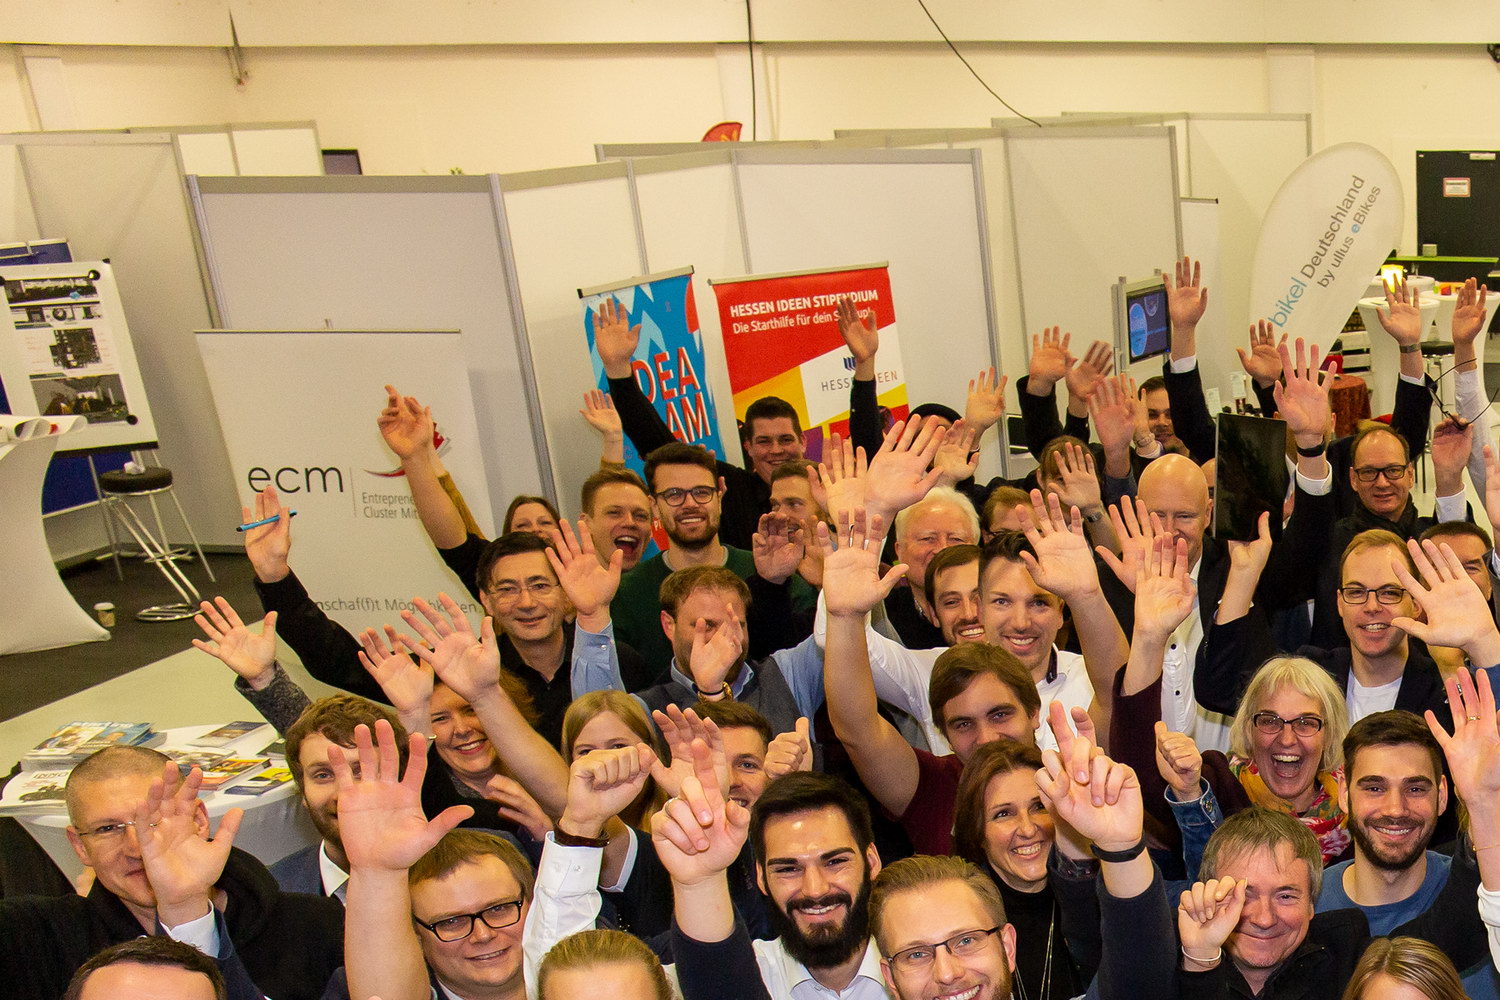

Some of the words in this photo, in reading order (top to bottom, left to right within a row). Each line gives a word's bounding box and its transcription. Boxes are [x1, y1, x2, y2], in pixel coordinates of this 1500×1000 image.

[1300, 175, 1365, 279] Deutschland
[1317, 270, 1336, 288] by
[1351, 186, 1381, 234] eBikes
[730, 301, 775, 318] HESSEN
[776, 297, 812, 312] IDEEN
[813, 289, 879, 308] STIPENDIUM
[733, 322, 749, 335] Die
[751, 316, 795, 332] Starthilfe
[796, 314, 811, 327] für
[813, 311, 831, 324] dein
[631, 347, 701, 403] DEA
[821, 377, 853, 391] HESS
[877, 370, 898, 384] EEN
[248, 466, 344, 493] ecm
[362, 492, 416, 508] Entreprene
[364, 507, 398, 519] Cluster
[401, 508, 419, 519] Mit
[317, 597, 381, 612] nschaf(f)t
